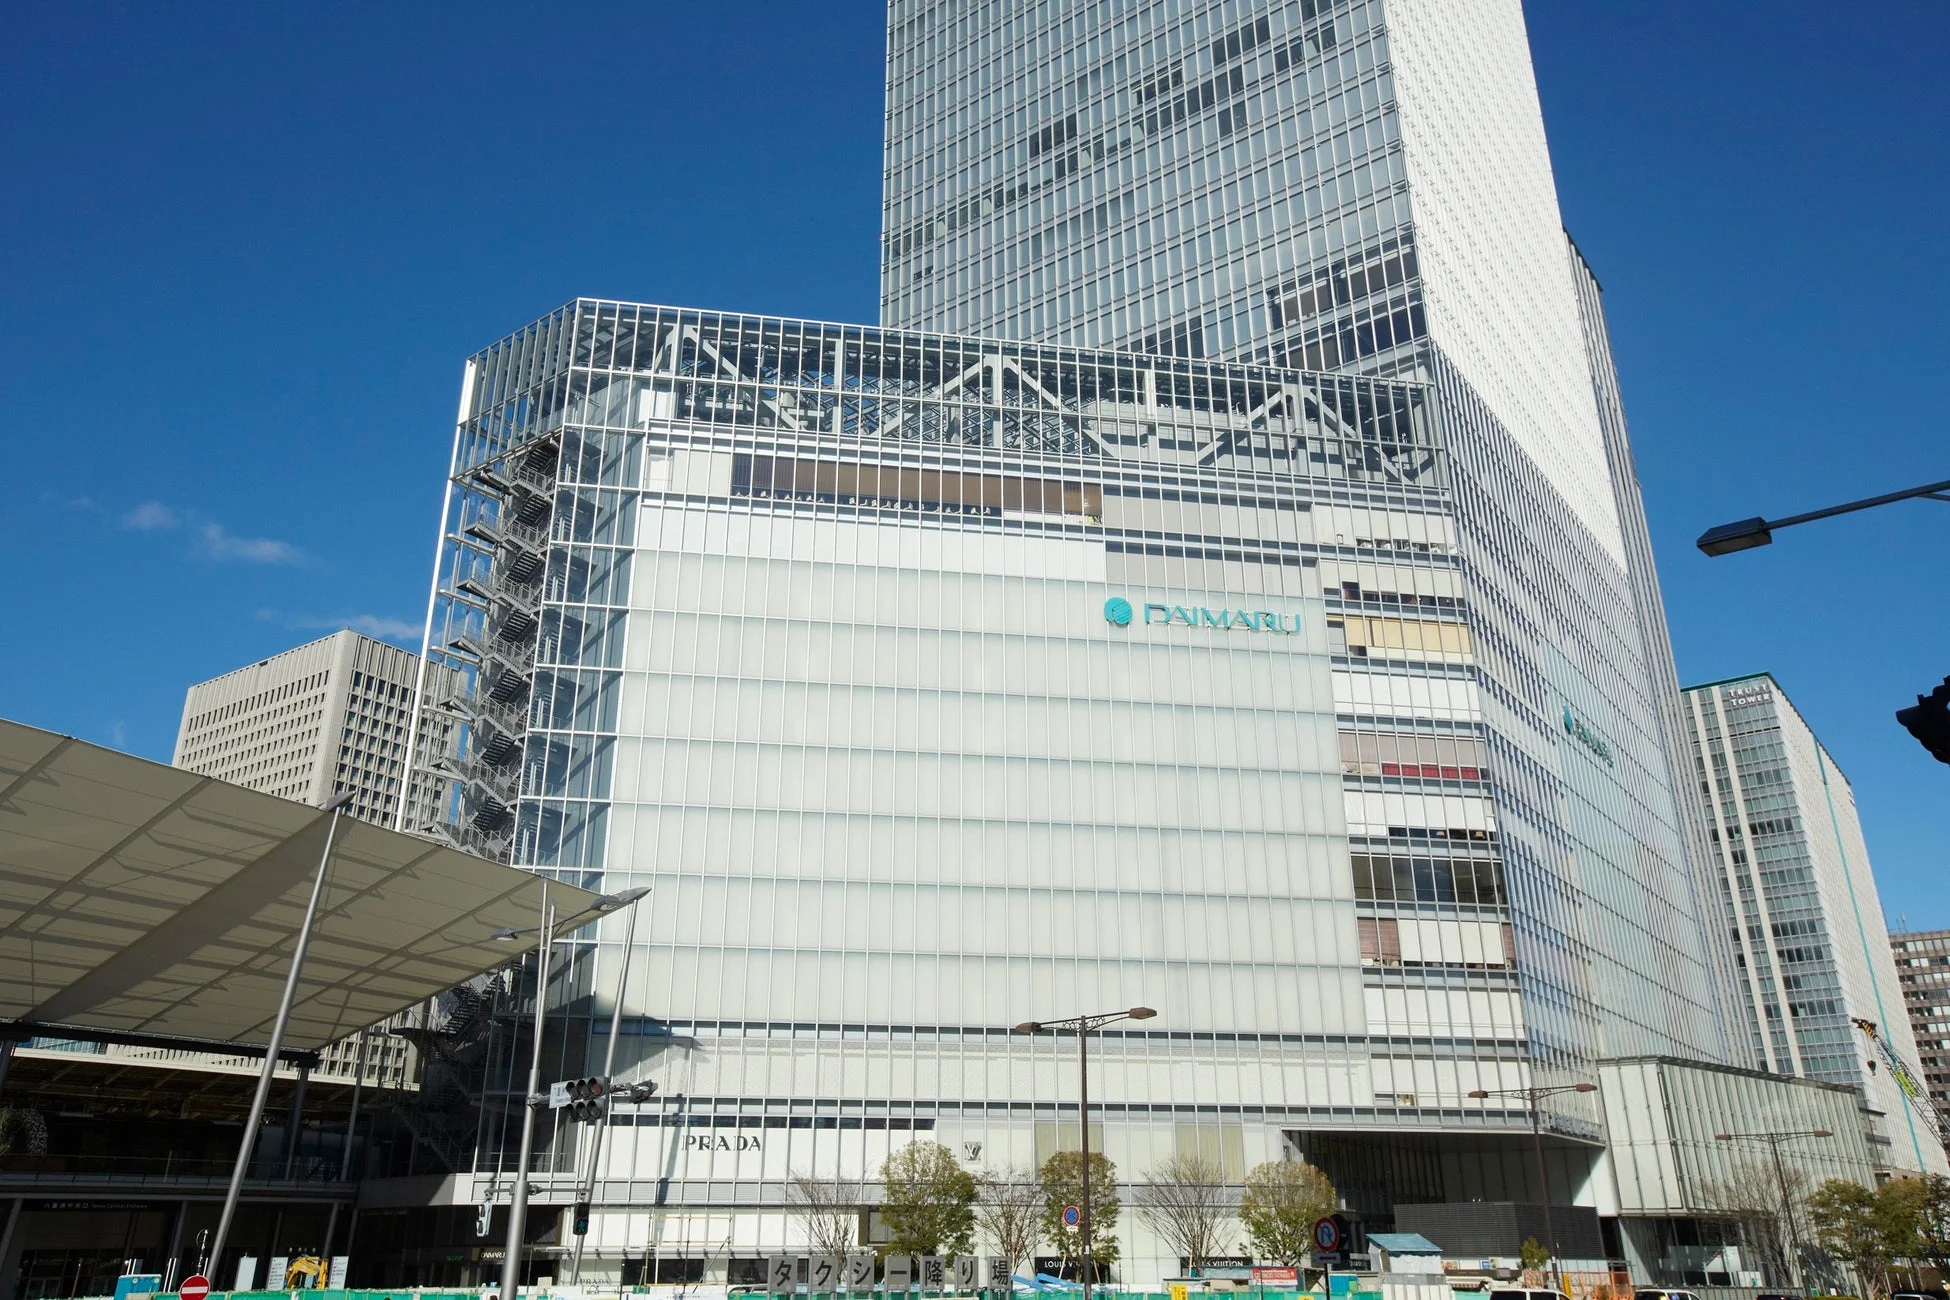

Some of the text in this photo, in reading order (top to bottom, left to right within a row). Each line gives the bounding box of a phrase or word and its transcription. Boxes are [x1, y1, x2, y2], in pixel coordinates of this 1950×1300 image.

[1144, 603, 1301, 633] DAIMARU
[1728, 684, 1767, 697] TRUST
[1730, 693, 1770, 706] TOWER
[681, 1135, 761, 1151] PRADA
[775, 1260, 1009, 1287] タクシー降り場
